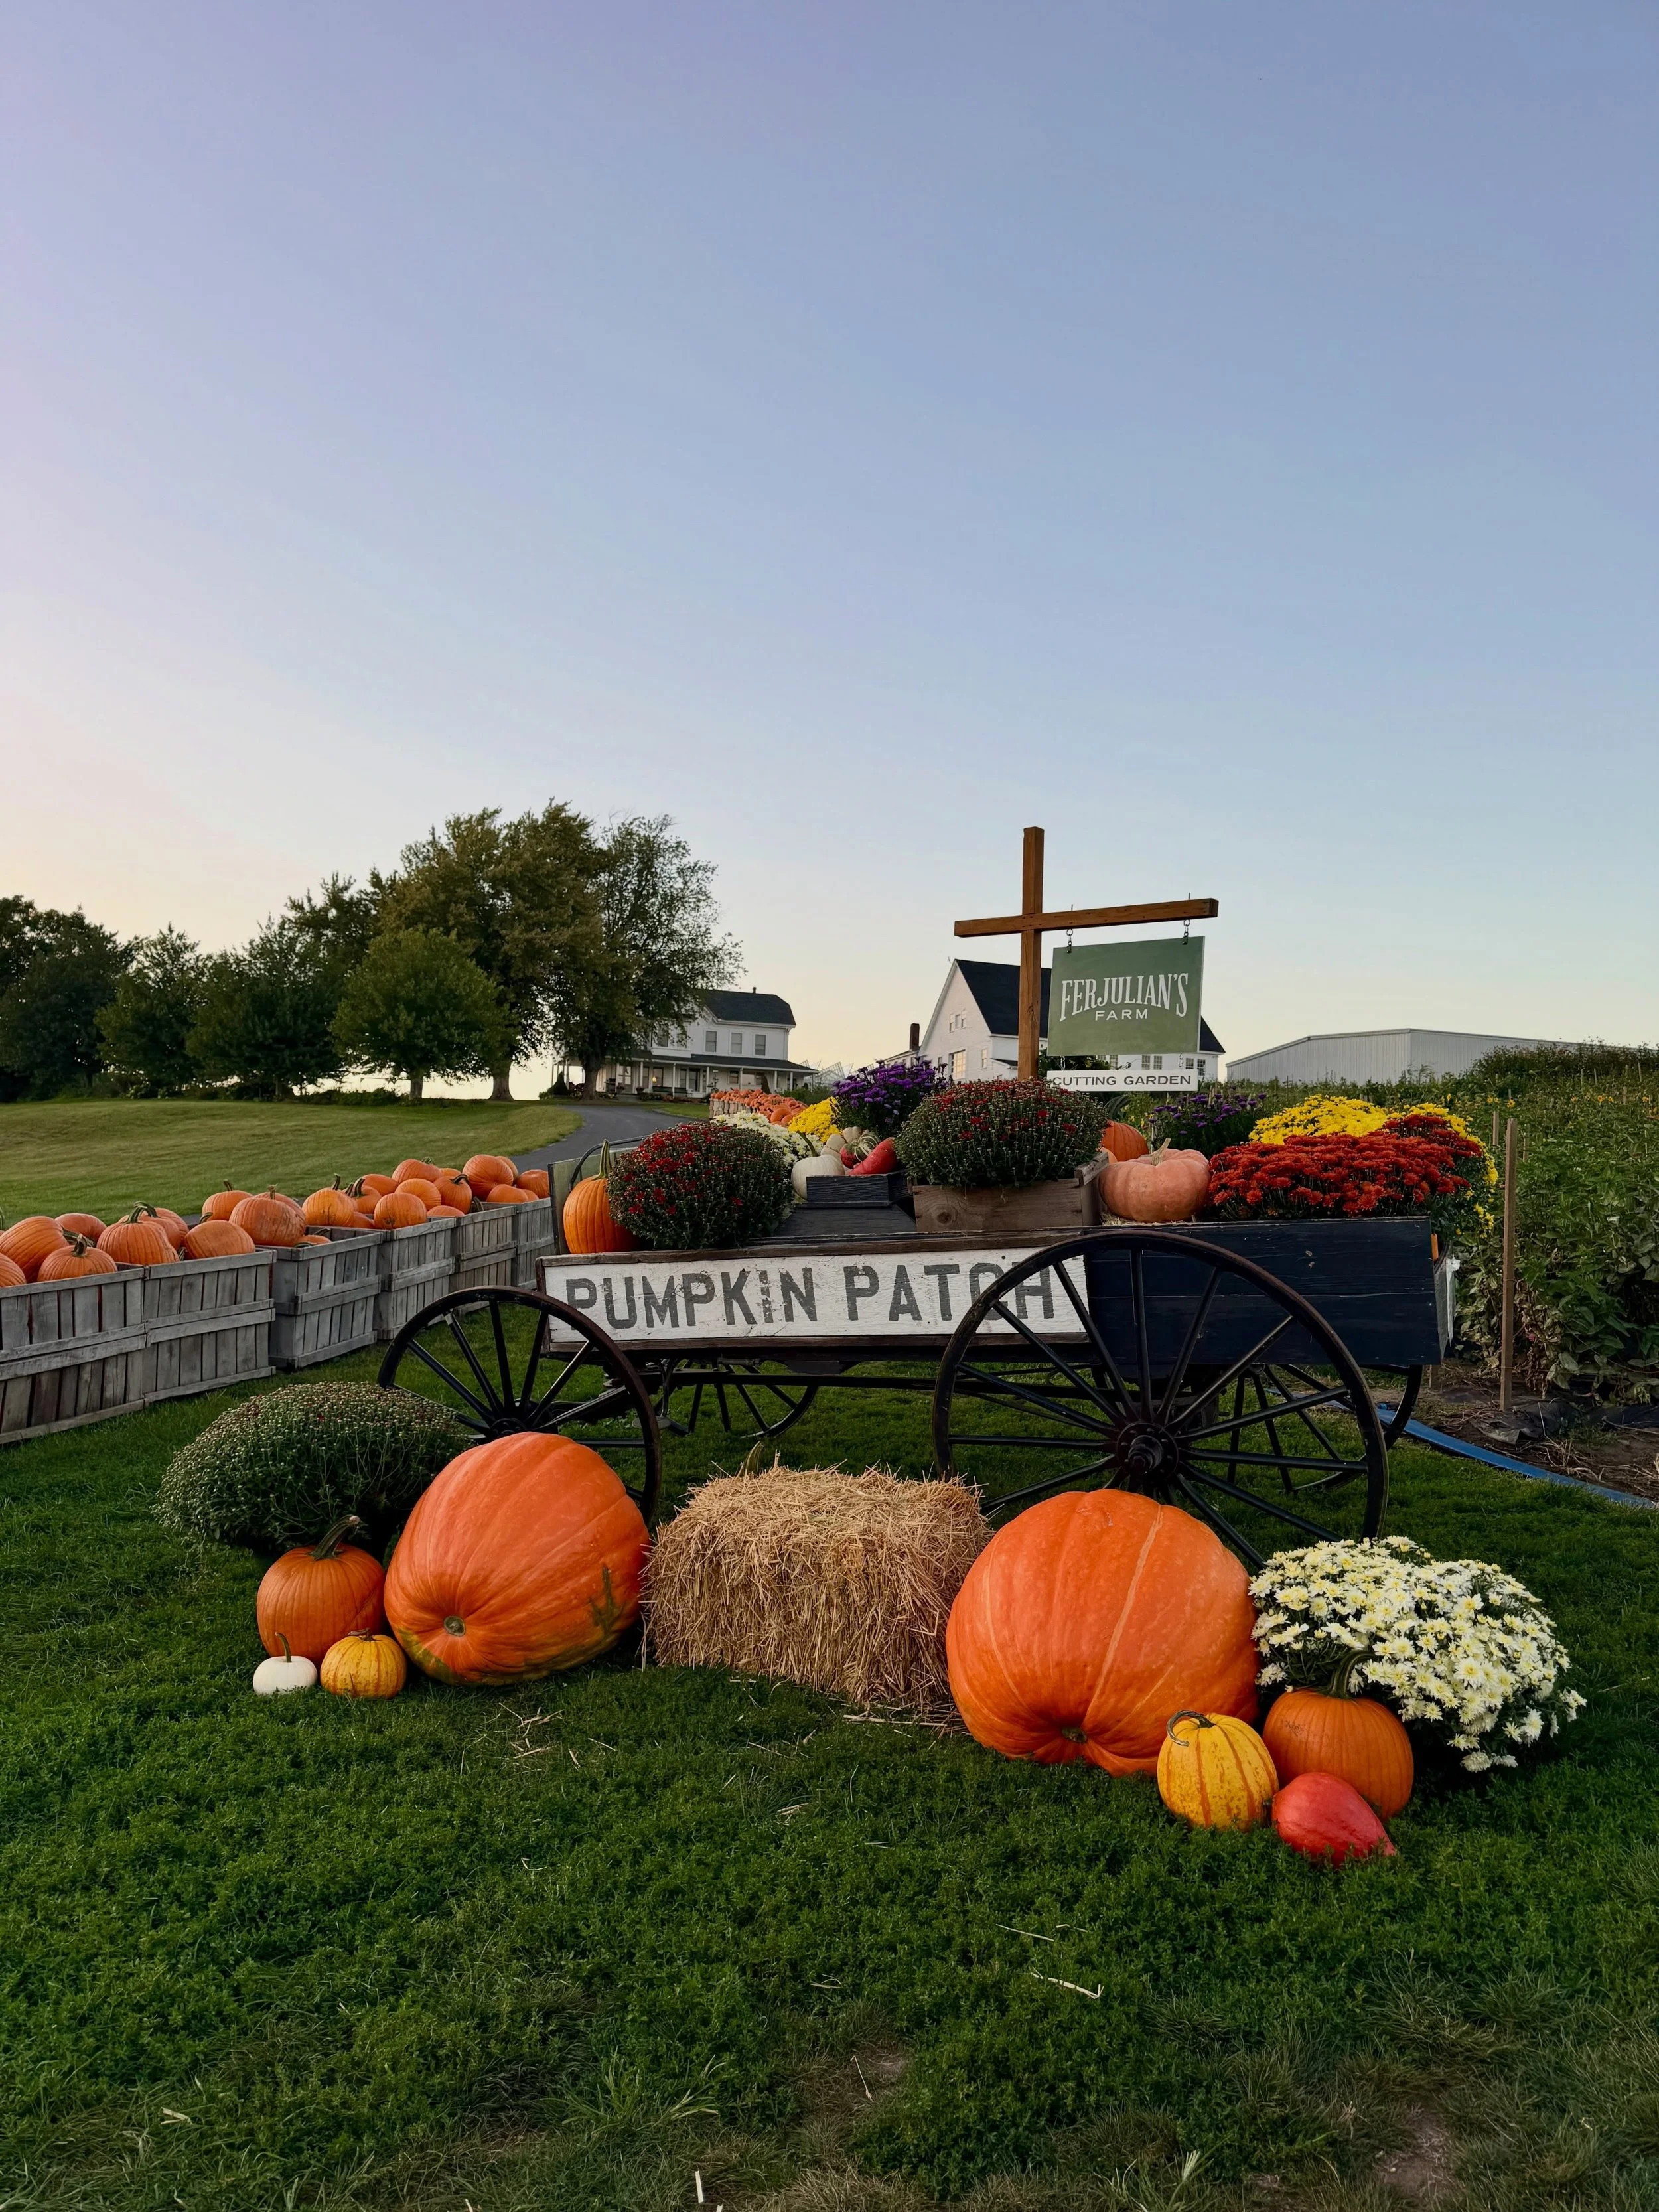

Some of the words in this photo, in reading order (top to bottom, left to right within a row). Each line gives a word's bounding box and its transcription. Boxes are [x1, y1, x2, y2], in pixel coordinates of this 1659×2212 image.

[1095, 1009, 1148, 1021] FARM
[1052, 1076, 1116, 1086] CUTTING
[1123, 1075, 1191, 1085] GARDEN
[566, 1267, 818, 1330] PUMPKIN
